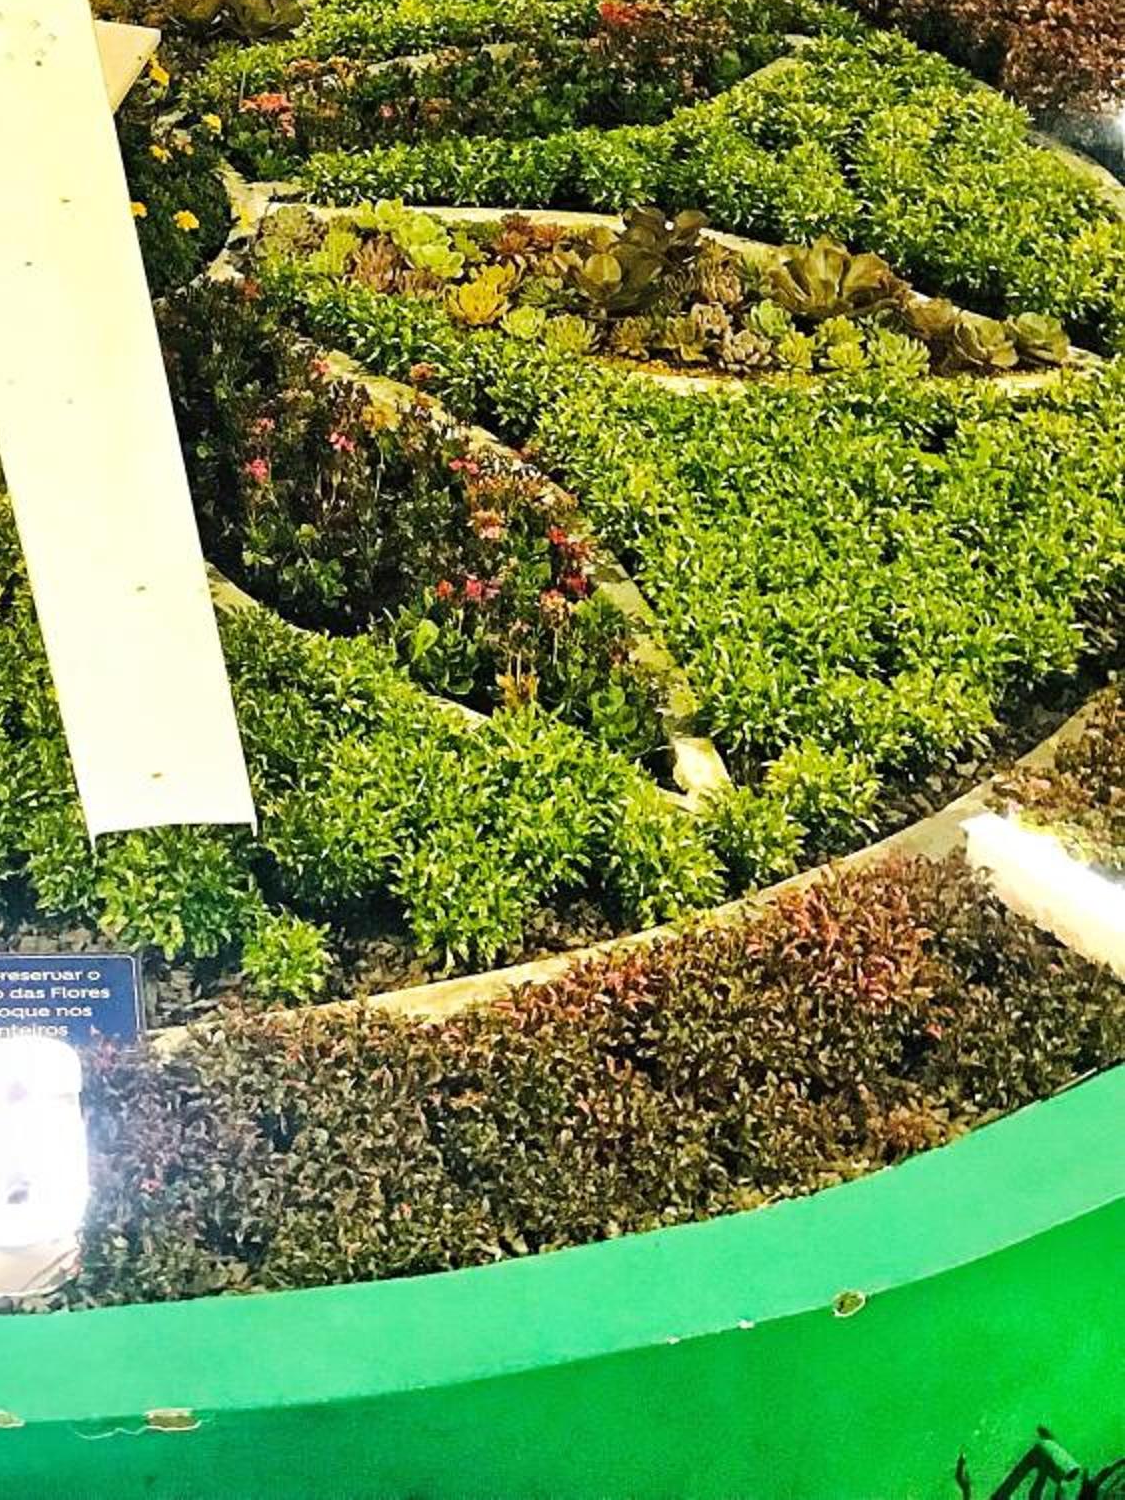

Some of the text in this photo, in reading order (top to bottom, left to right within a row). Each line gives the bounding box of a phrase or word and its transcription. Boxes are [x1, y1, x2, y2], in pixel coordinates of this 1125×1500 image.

[87, 970, 101, 981] o
[9, 987, 45, 999] das
[50, 986, 111, 999] Flores
[56, 1006, 92, 1017] nos
